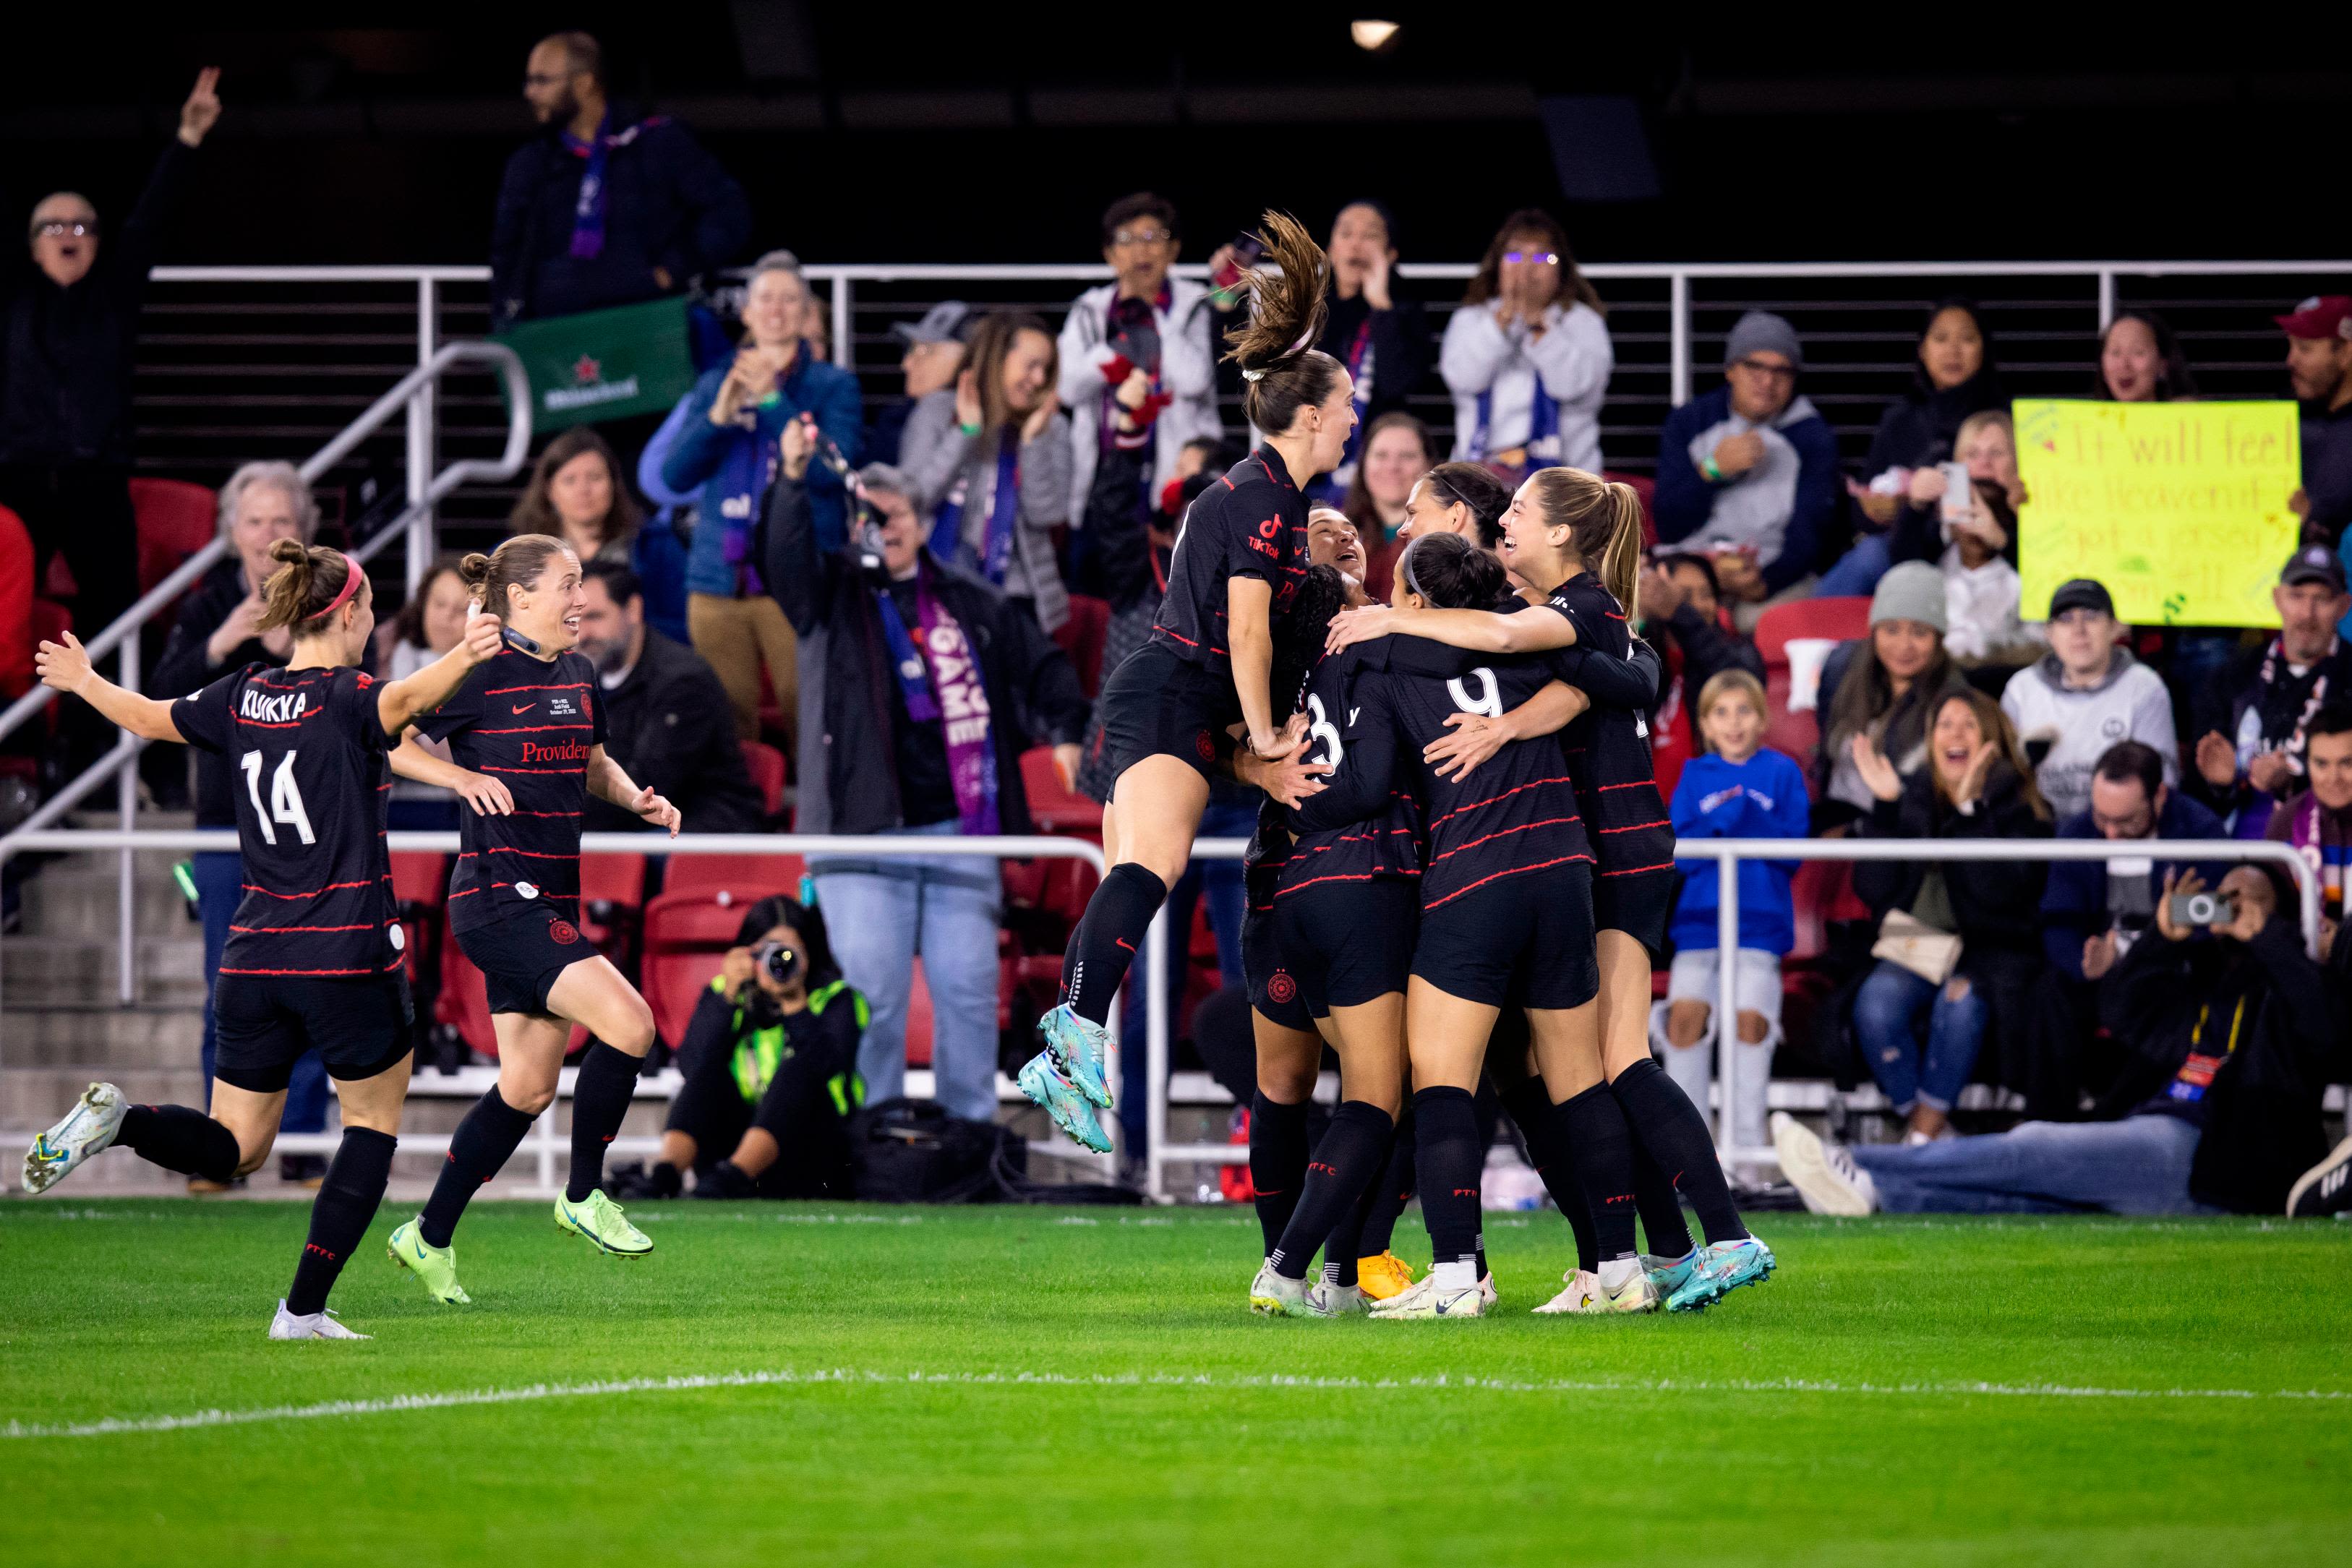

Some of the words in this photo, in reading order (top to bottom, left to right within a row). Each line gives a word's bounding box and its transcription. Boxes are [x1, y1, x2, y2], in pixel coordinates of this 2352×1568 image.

[2129, 419, 2202, 464] will
[2221, 416, 2293, 467] feel
[1248, 536, 1280, 560] TikTok
[241, 749, 316, 844] 14
[1453, 1188, 1477, 1197] PTF
[307, 1243, 335, 1260] PTFC
